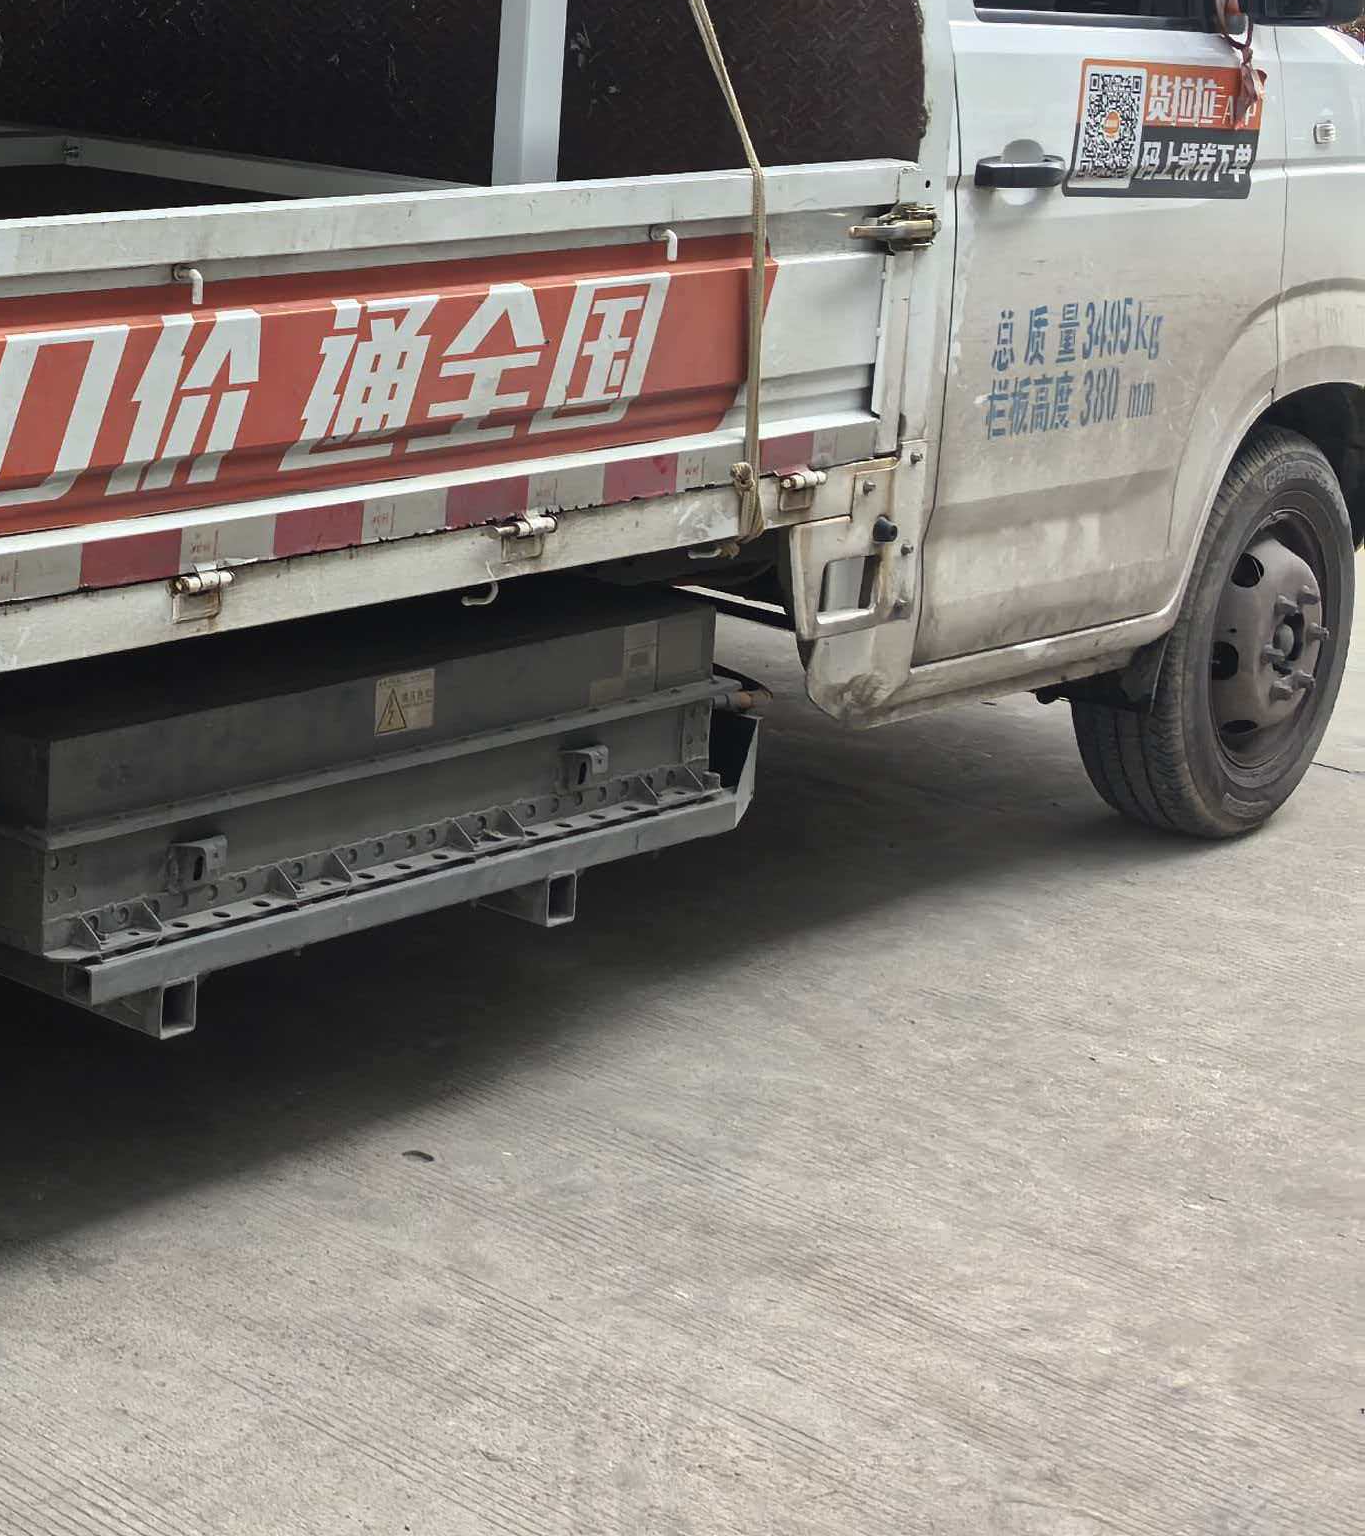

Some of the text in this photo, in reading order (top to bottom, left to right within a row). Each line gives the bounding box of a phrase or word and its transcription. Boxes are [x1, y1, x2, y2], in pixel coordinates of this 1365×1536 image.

[1145, 74, 1220, 128] 货拉拉
[1133, 141, 1253, 182] 码上领券下单
[277, 270, 673, 473] 通全国
[985, 371, 1074, 440] 栏板高度
[1080, 367, 1120, 427] 380
